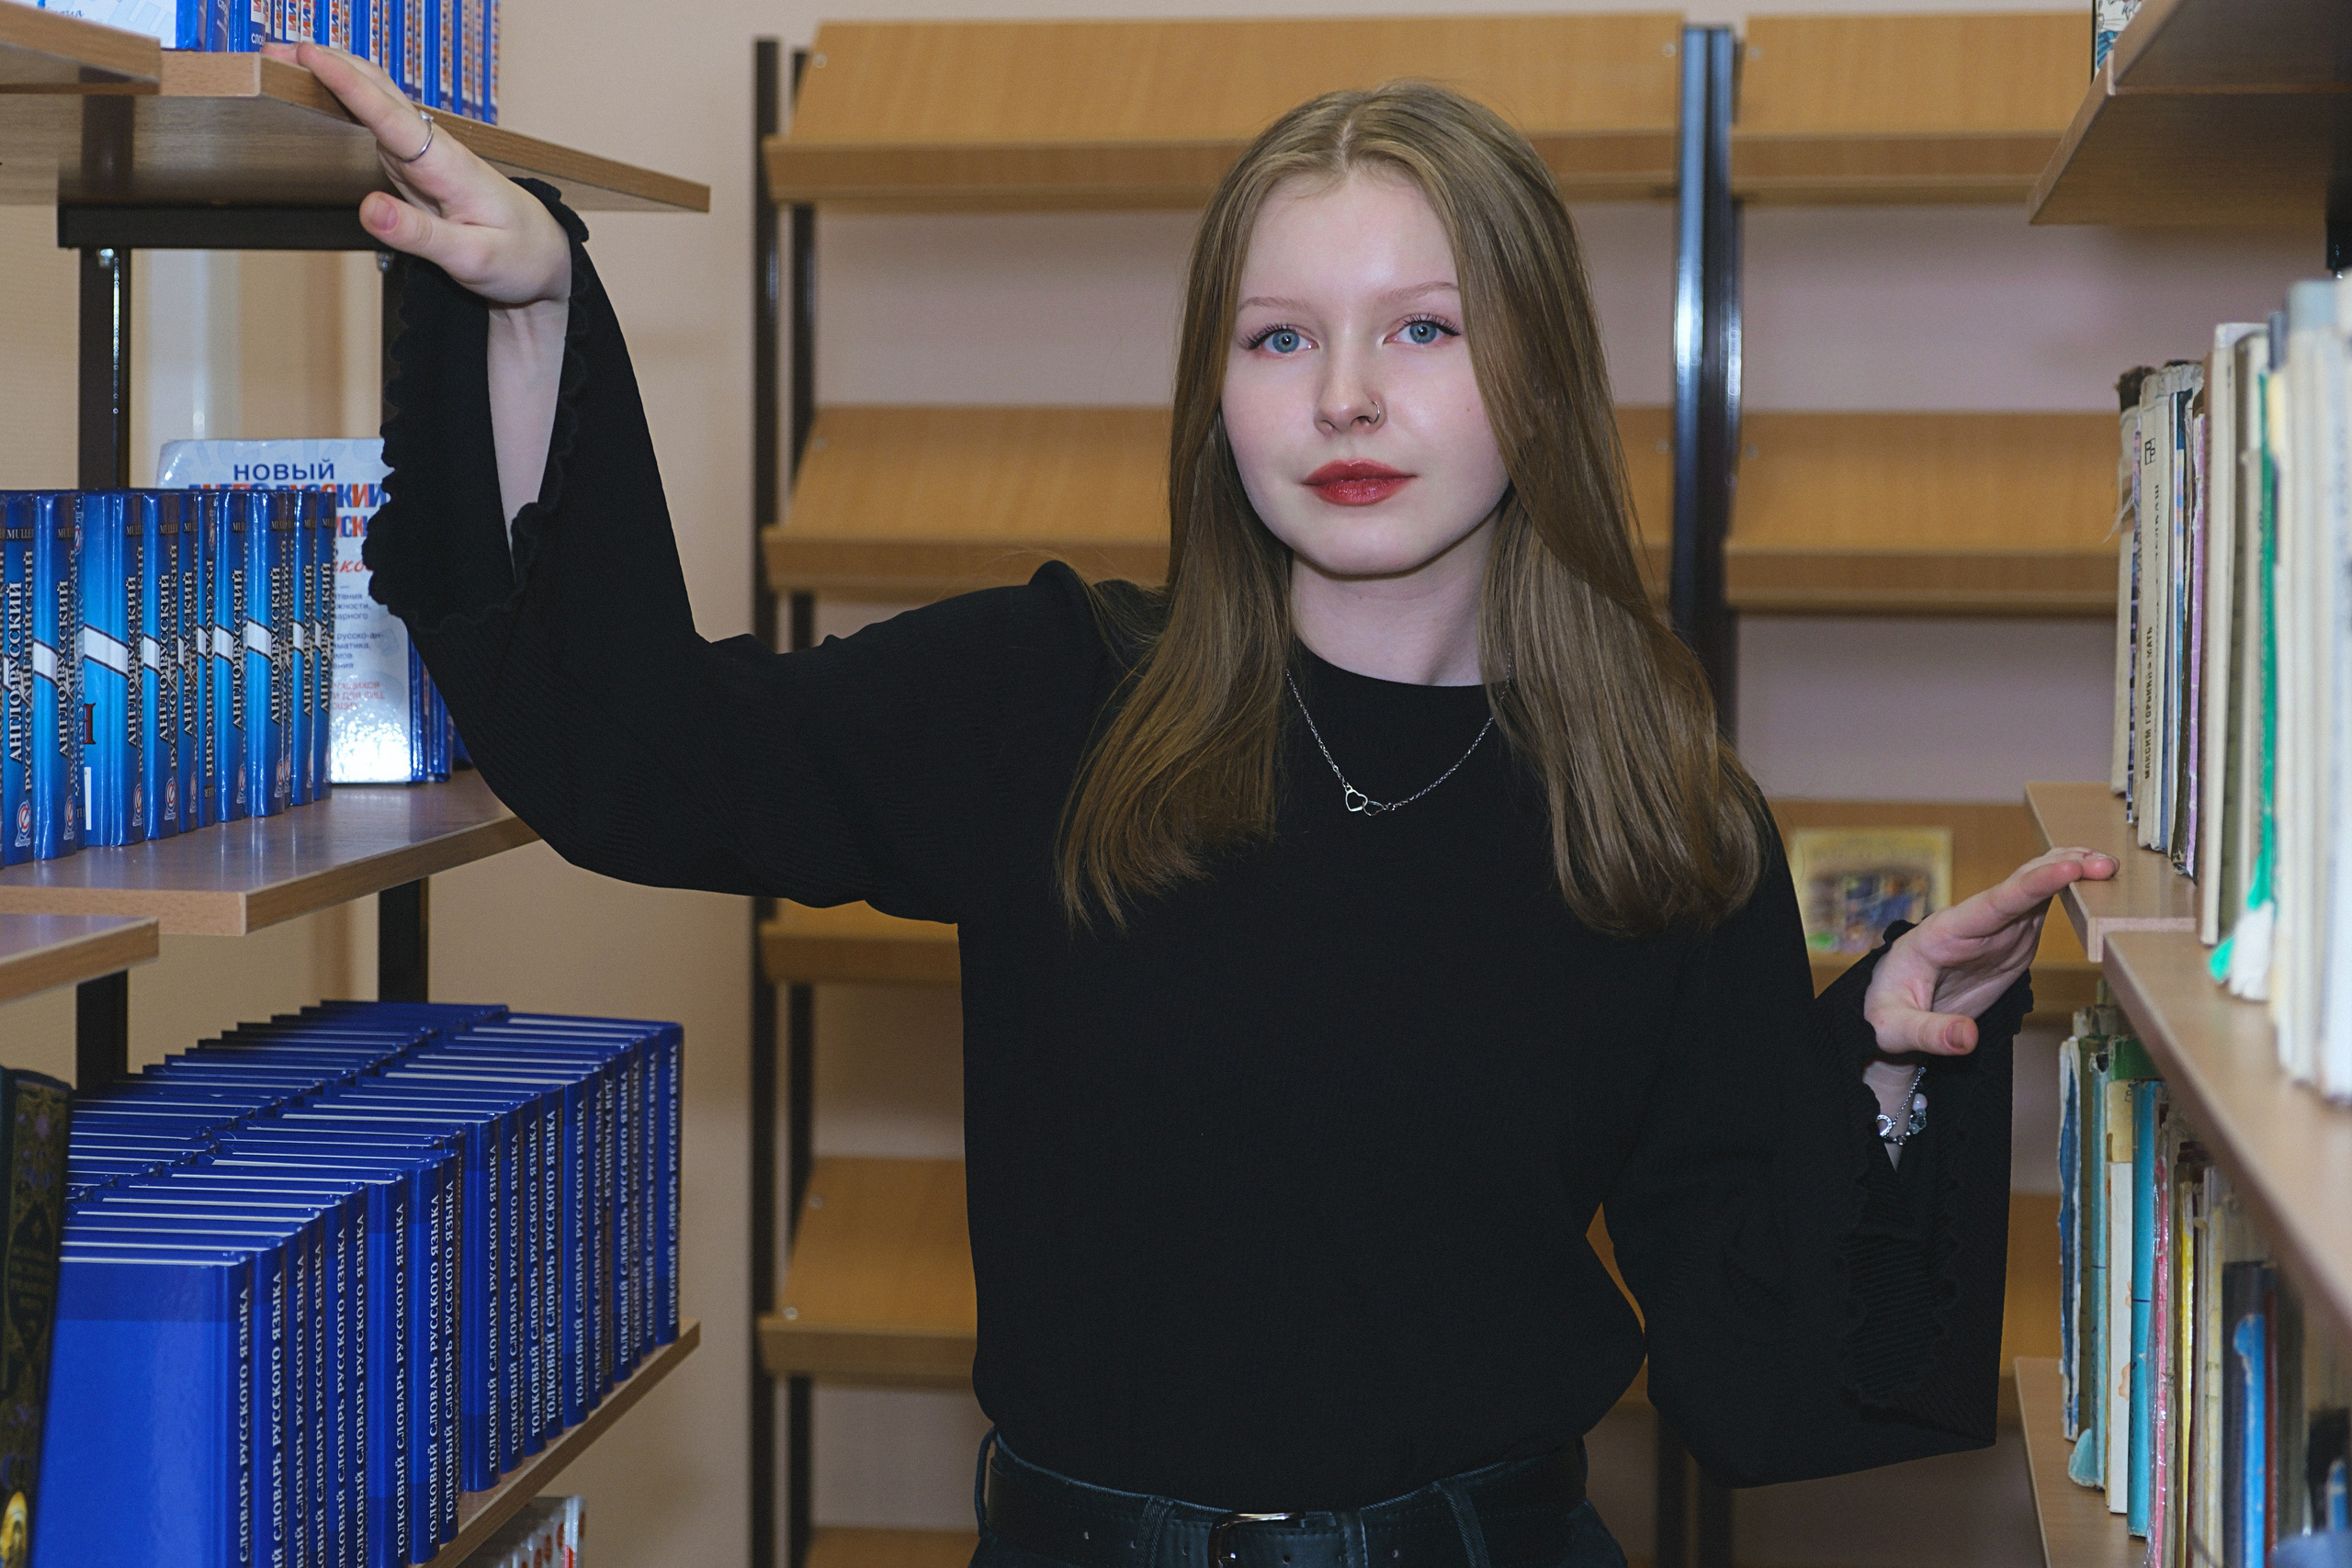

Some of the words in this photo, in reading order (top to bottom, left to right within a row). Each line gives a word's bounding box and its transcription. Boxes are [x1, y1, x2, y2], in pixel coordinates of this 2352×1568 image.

[233, 458, 334, 480] НОВЫЙ
[6, 581, 22, 762] АНГЛО-РУССКИЙ
[57, 581, 68, 757] АНГЛО-РУССКИЙ
[126, 577, 136, 745] АНГЛО-РУССКИЙ
[159, 575, 169, 741] АНГЛО-РУССКИЙ
[183, 571, 192, 734] АНГЛО-РУССКИЙ
[206, 560, 214, 777] РУССКО-АНГЛИЙСКИЙ
[232, 570, 243, 728] АНГЛО-РУССКИЙ
[270, 568, 280, 726] АНГЛО-РУССКИЙ
[303, 565, 312, 716] АНГЛО-РУССКИЙ
[321, 563, 331, 713] АНГЛО-РУССКИЙ
[546, 1110, 555, 1167] ЯЗЫКА
[576, 1100, 584, 1155] ЯЗЫКА
[620, 1071, 628, 1123] ЯЗЫКА
[669, 1098, 677, 1171] РУССКОГО
[605, 1113, 613, 1197] УЧАЩИХСЯ
[620, 1127, 628, 1203] РУССКОГО
[396, 1203, 404, 1266] ЯЗЫКА
[431, 1194, 439, 1257] ЯЗЫКА
[446, 1180, 454, 1242] ЯЗЫКА
[529, 1181, 537, 1263] РУССКОГО
[546, 1170, 555, 1251] РУССКОГО
[575, 1159, 583, 1237] РУССКОГО
[669, 1176, 677, 1241] СЛОВАРЬ
[337, 1228, 345, 1293] ЯЗЫКА
[575, 1242, 583, 1313] СЛОВАРЬ
[620, 1207, 628, 1276] СЛОВАРЬ
[240, 1288, 248, 1359] ЯЗЫКА
[272, 1271, 281, 1340] ЯЗЫКА
[296, 1255, 304, 1323] ЯЗЫКА
[396, 1271, 404, 1362] РУССКОГО
[429, 1261, 438, 1352] РУССКОГО
[445, 1247, 453, 1335] РУССКОГО
[530, 1267, 538, 1340] СЛОВАРЬ
[546, 1255, 555, 1327] СЛОВАРЬ
[619, 1280, 628, 1365] ТОЛКОВЫЙ
[667, 1245, 676, 1327] ТОЛКОВЫЙ
[272, 1346, 281, 1447] РУССКОГО
[429, 1357, 438, 1437] СЛОВАРЬ
[445, 1339, 453, 1419] СЛОВАРЬ
[529, 1345, 540, 1437] ТОЛКОВЫЙ
[545, 1332, 556, 1422] ТОЛКОВЫЙ
[574, 1318, 584, 1406] ТОЛКОВЫЙ
[240, 1364, 248, 1466] РУССКОГО
[337, 1399, 345, 1483] СЛОВАРЬ
[488, 1377, 497, 1472] ТОЛКОВЫЙ
[509, 1361, 518, 1454] ТОЛКОВЫЙ
[273, 1451, 282, 1541] СЛОВАРЬ
[395, 1455, 405, 1557] ТОЛКОВЫЙ
[427, 1443, 438, 1543] ТОЛКОВЫЙ
[444, 1425, 453, 1524] ТОЛКОВЫЙ
[240, 1472, 248, 1562] СЛОВАРЬ
[315, 1508, 324, 1568] ОВЫЙ
[336, 1489, 345, 1568] ЛКОВЫЙ
[355, 1470, 364, 1568] ОЛКОВЫЙ
